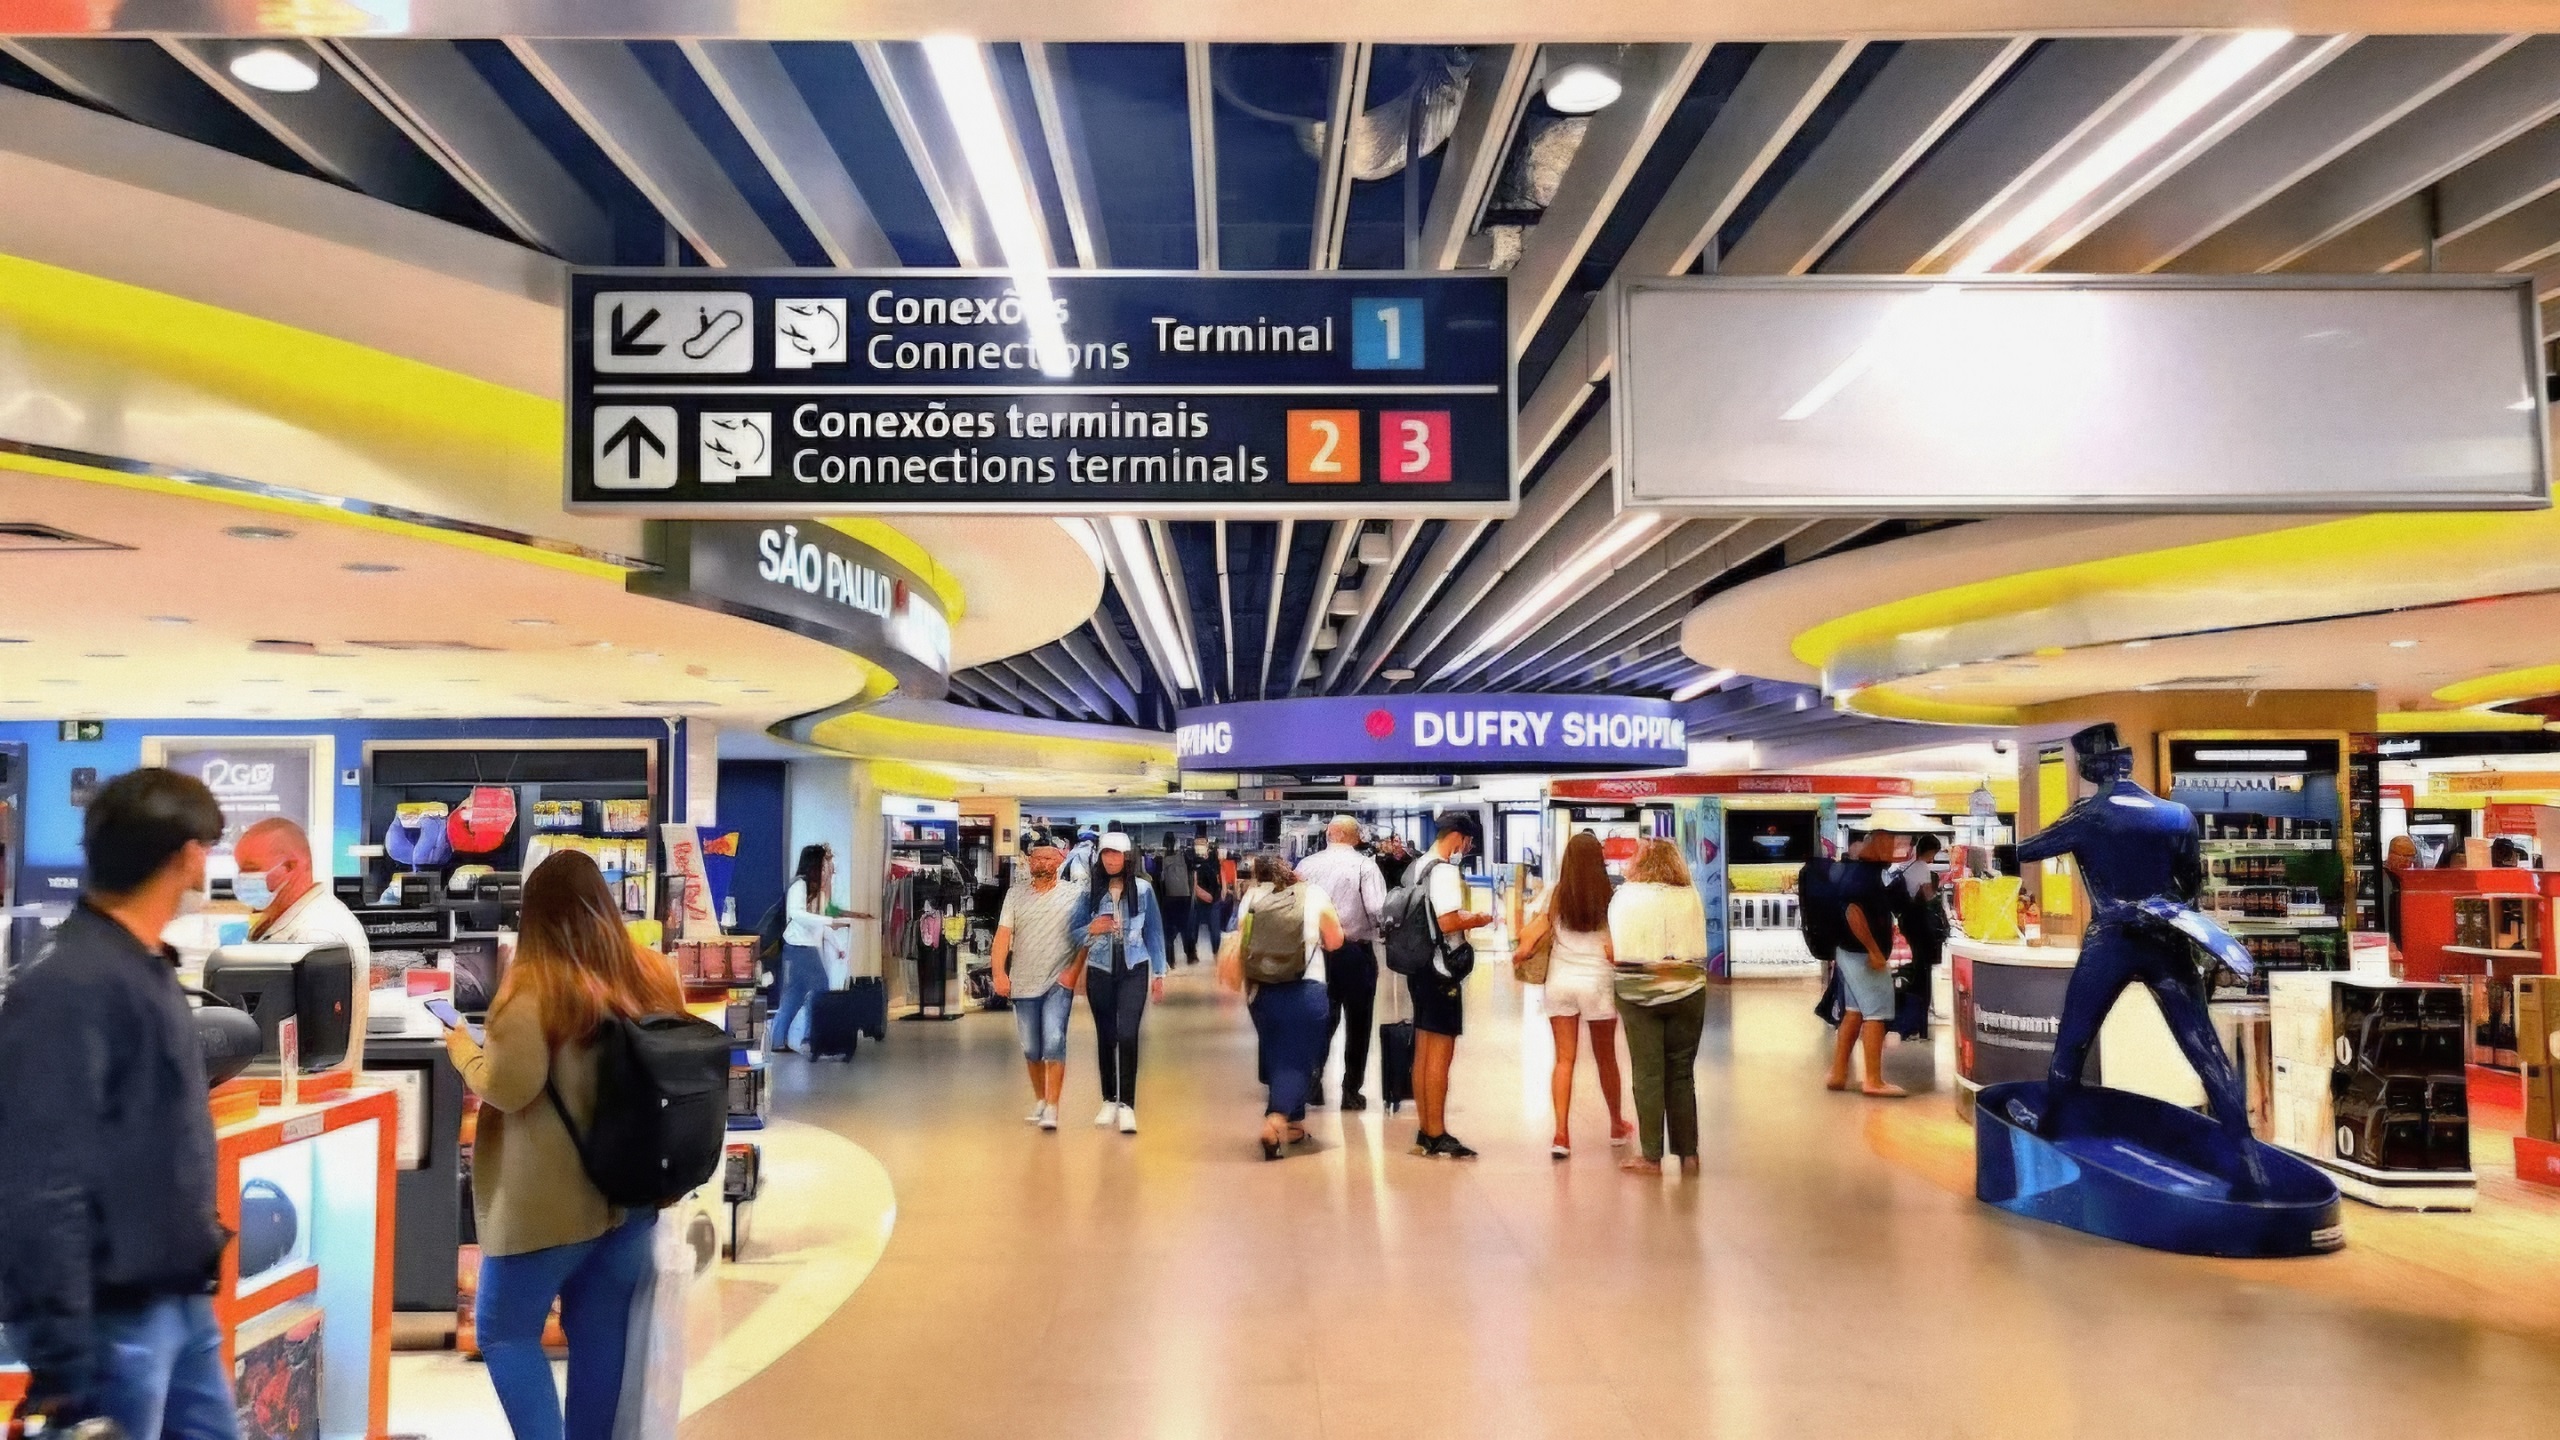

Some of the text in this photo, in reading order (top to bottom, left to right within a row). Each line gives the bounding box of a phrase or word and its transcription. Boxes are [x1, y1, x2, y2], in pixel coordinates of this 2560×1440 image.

[868, 289, 1069, 325] Conexõs
[1151, 307, 1401, 360] Terminal 1
[868, 335, 1130, 370] Connectons
[792, 401, 1209, 438] Conexões terminais
[792, 445, 1269, 484] Connections terminals
[1309, 419, 1431, 474] 2 3
[1414, 710, 1552, 747] DUFRY
